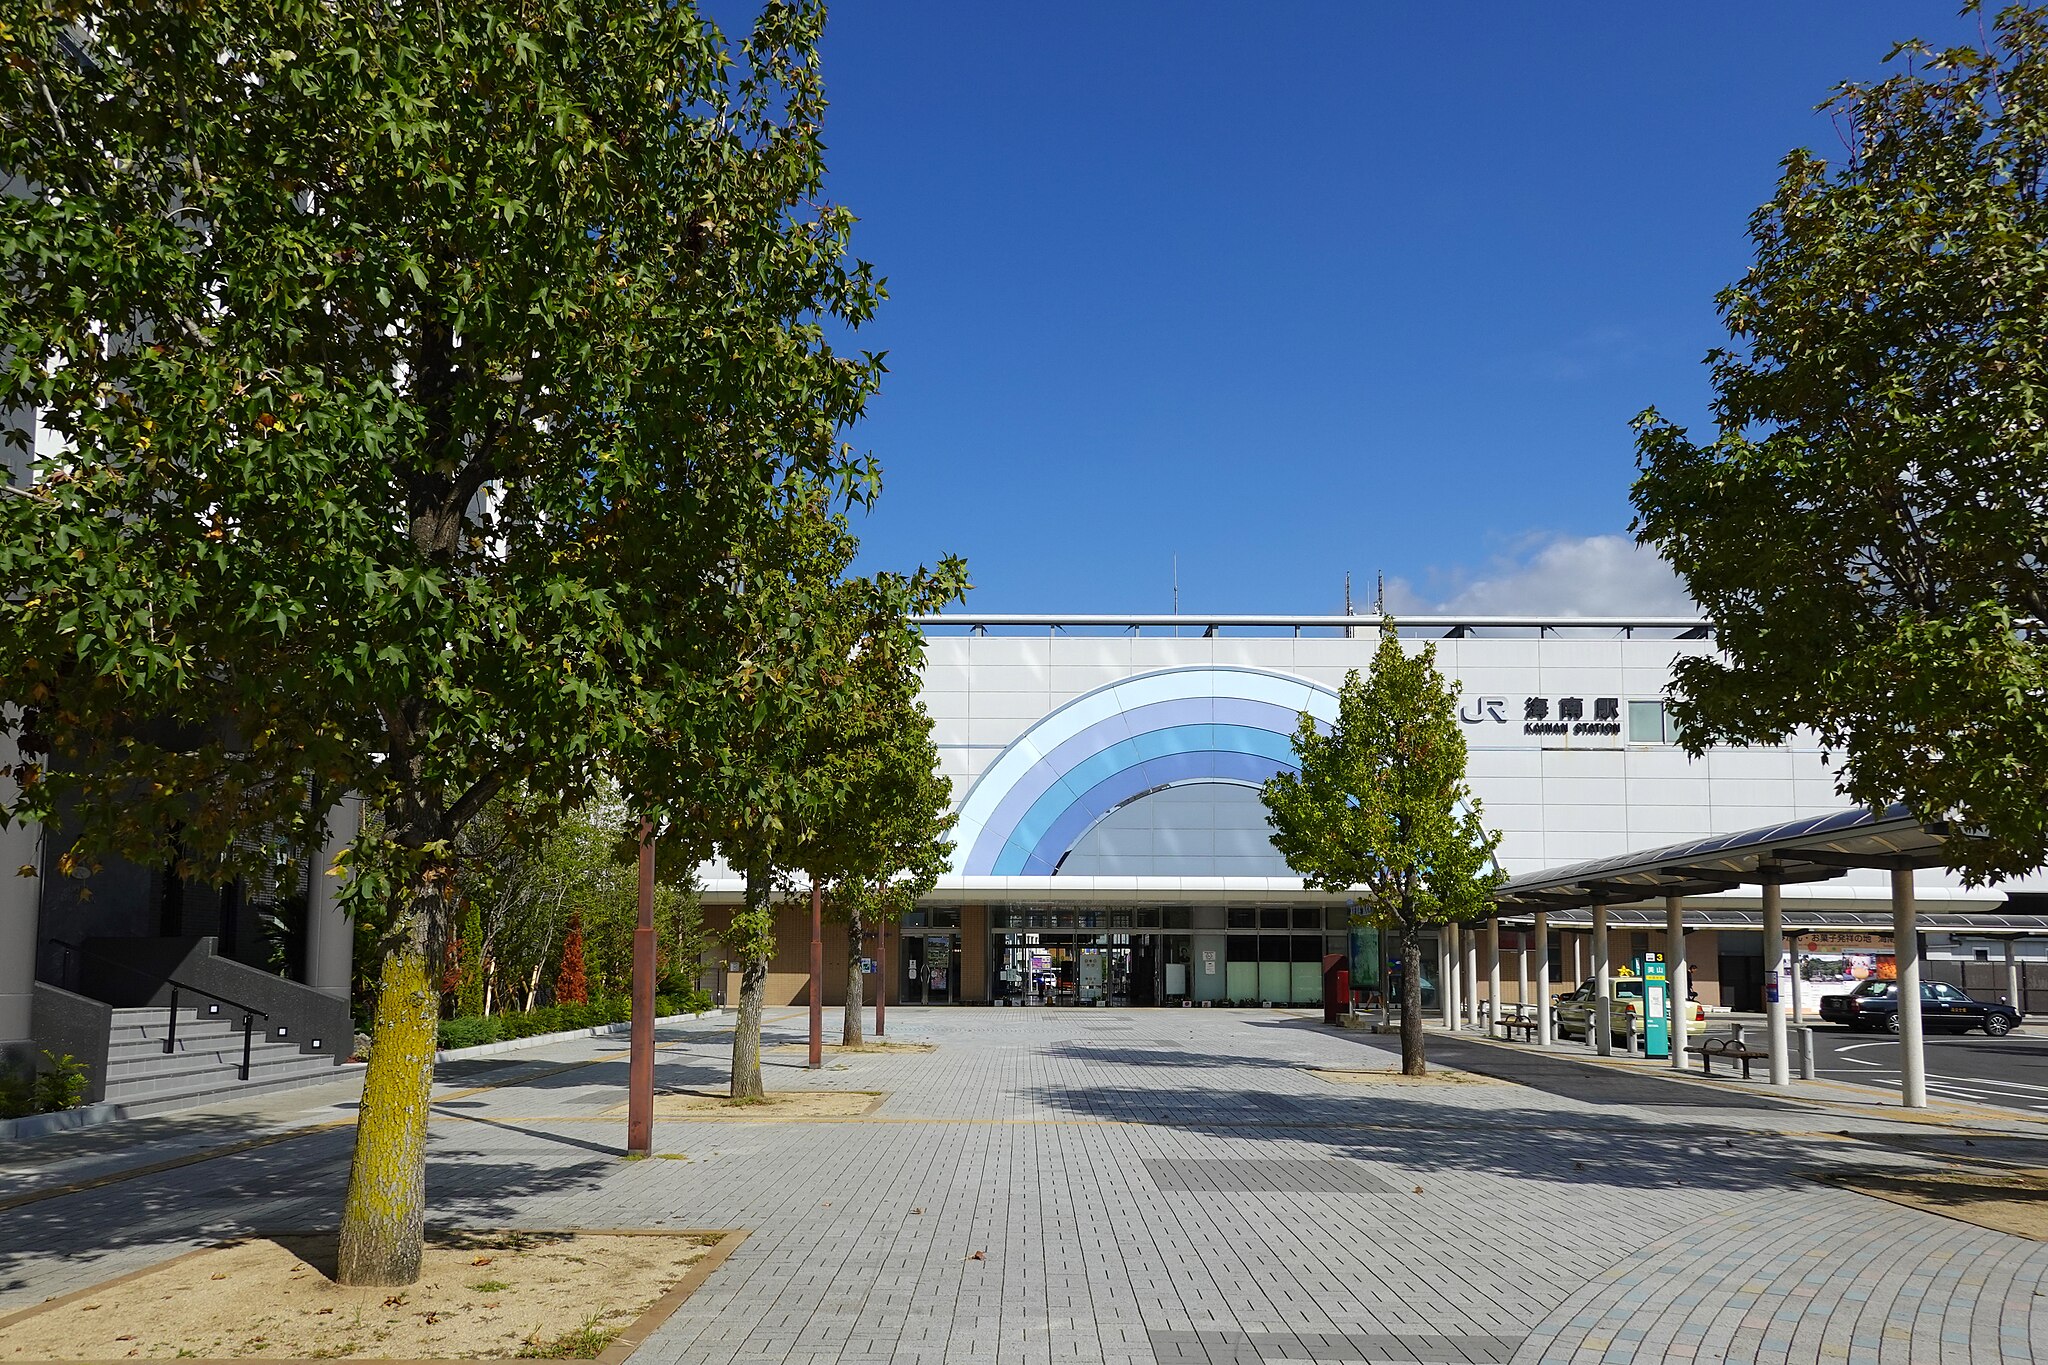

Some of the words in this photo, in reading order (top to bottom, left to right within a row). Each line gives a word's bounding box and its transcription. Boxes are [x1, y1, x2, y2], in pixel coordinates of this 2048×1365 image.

[1460, 696, 1509, 725] JR
[1524, 697, 1620, 722] 海南駅
[1524, 723, 1569, 736] KAINAN
[1573, 723, 1621, 736] STATION
[1656, 953, 1663, 962] 3
